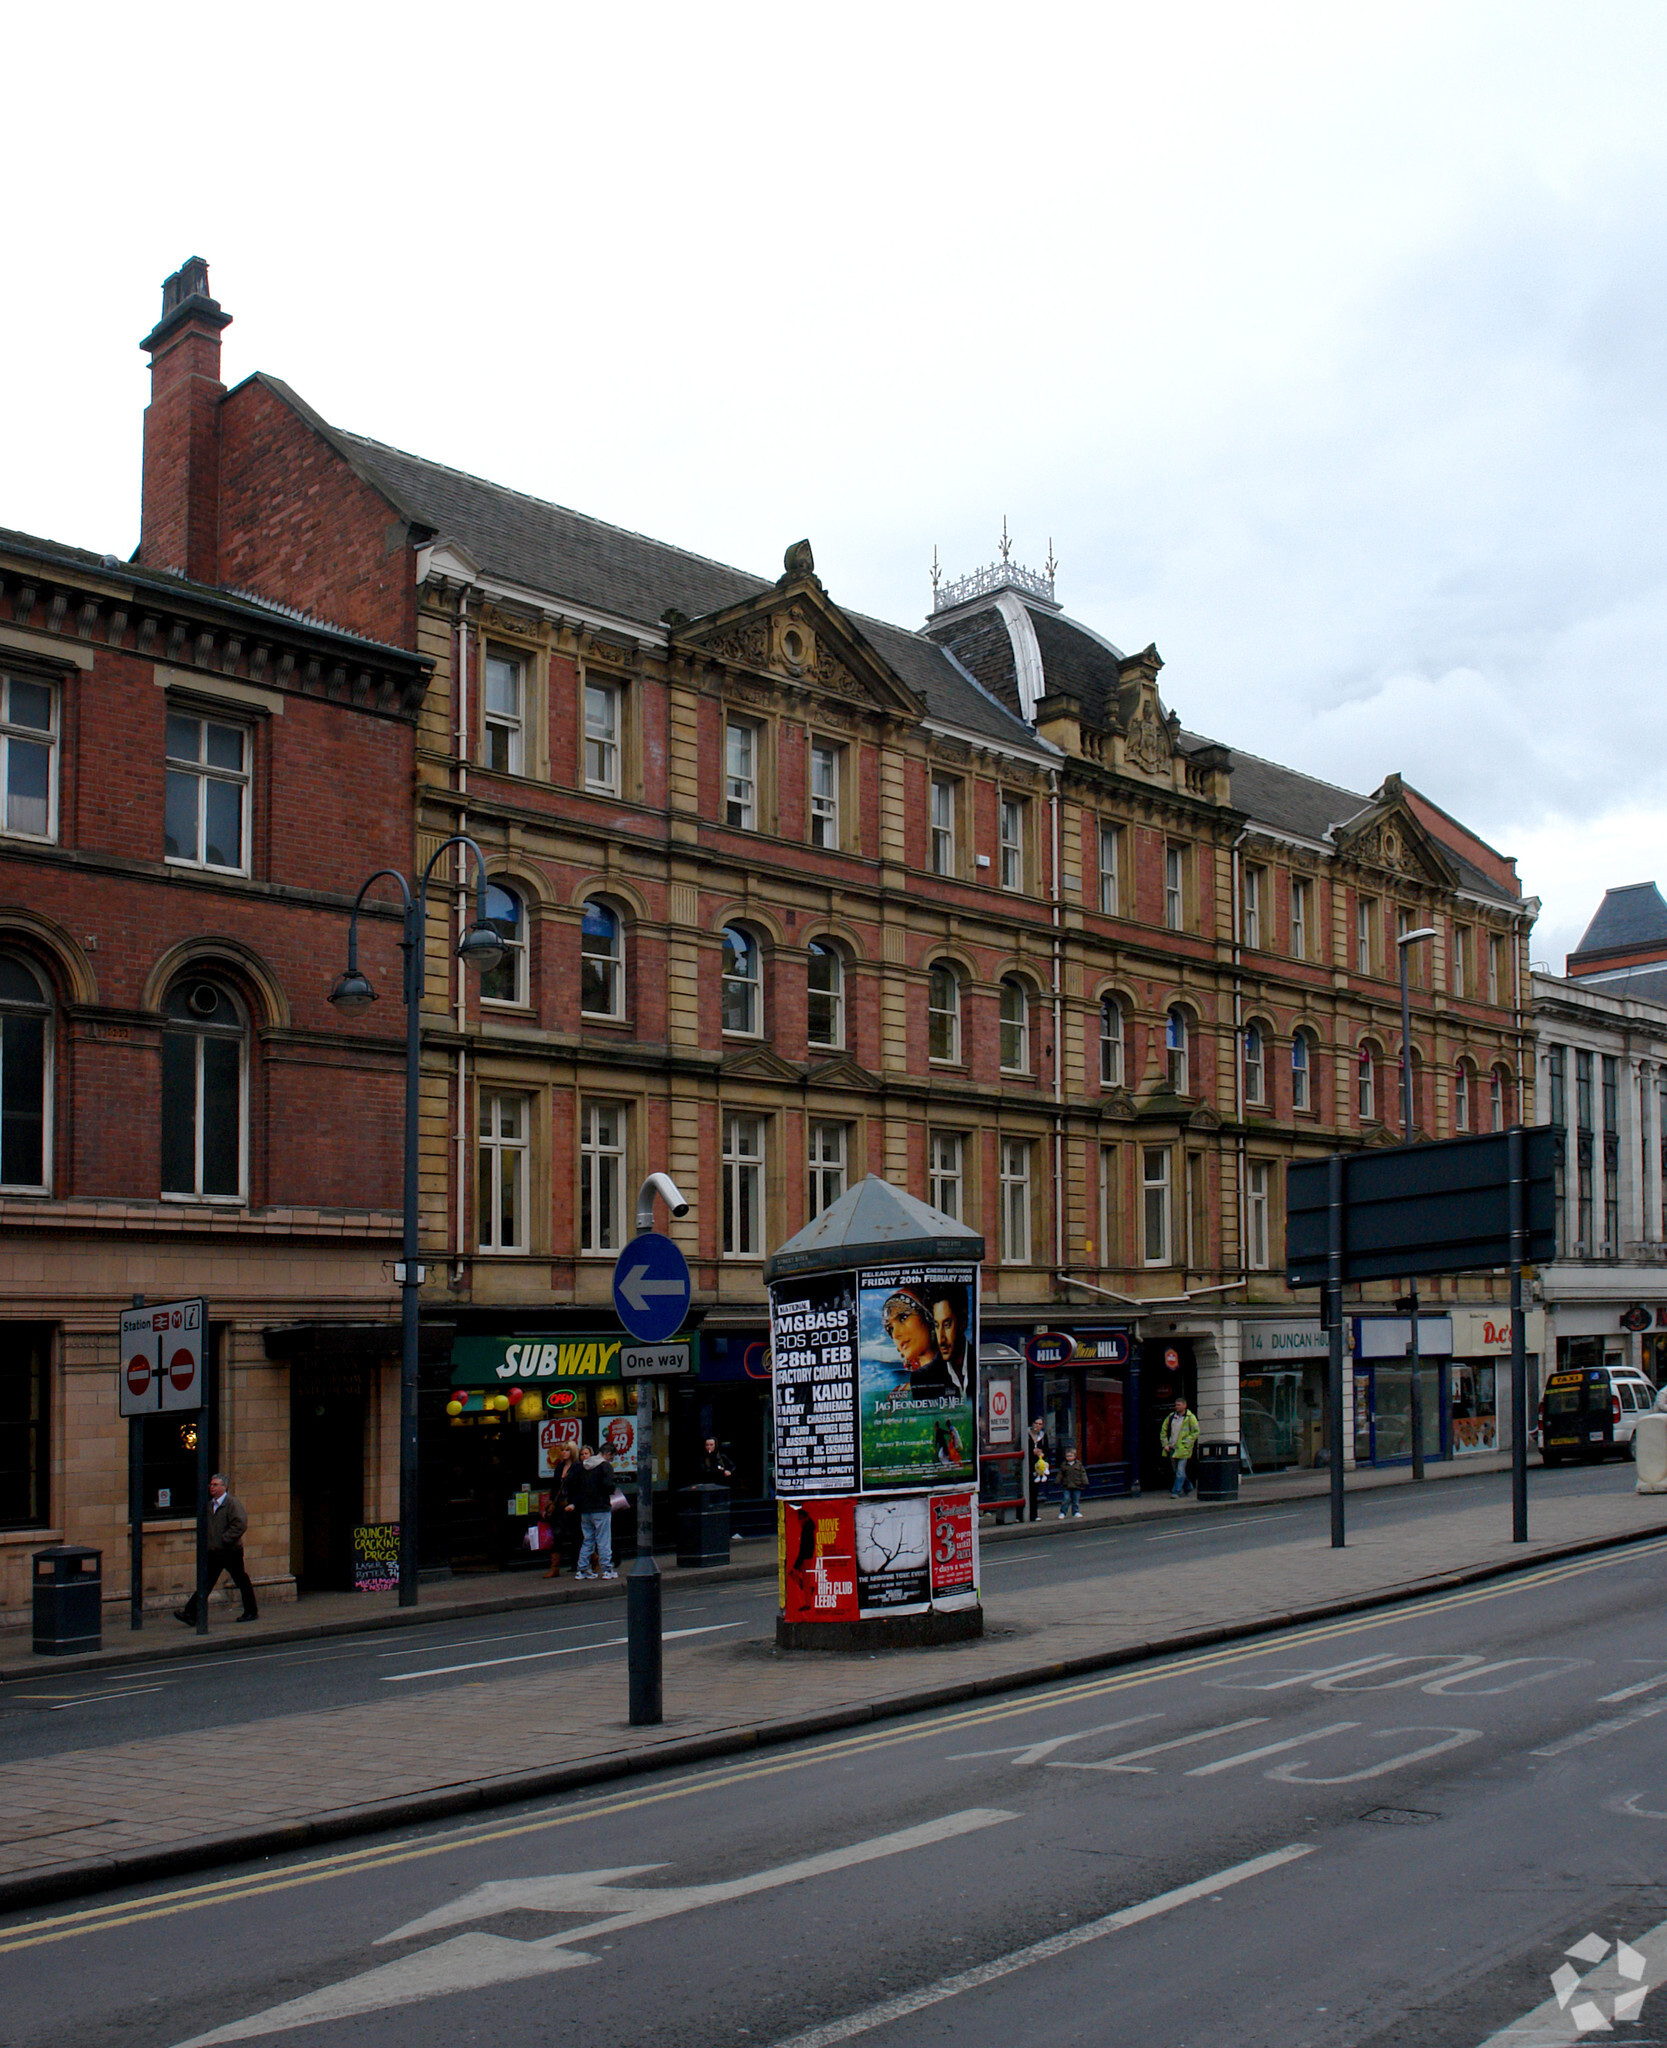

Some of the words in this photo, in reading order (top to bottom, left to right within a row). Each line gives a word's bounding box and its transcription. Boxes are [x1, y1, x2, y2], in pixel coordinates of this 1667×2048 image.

[861, 1269, 901, 1278] RELEASING
[901, 1268, 910, 1276] IN
[861, 1277, 897, 1287] FRIDAY
[899, 1275, 921, 1285] 20th
[924, 1274, 957, 1283] FEBRUARY
[957, 1274, 973, 1283] 2009
[123, 1320, 151, 1332] Station
[776, 1336, 806, 1350] RDS
[811, 1328, 850, 1347] 2009
[1250, 1334, 1263, 1350] 14
[1271, 1333, 1312, 1349] DUNCAN
[1314, 1332, 1330, 1347] HOU
[1036, 1348, 1063, 1362] HILL
[1097, 1341, 1119, 1358] HILL
[496, 1340, 623, 1379] SUBWAY
[627, 1354, 653, 1368] One
[658, 1354, 684, 1368] way
[777, 1349, 817, 1369] 28th
[821, 1346, 853, 1364] FEB
[776, 1367, 812, 1385] FACTORY
[812, 1364, 854, 1382] COMPLEX
[1557, 1375, 1579, 1383] TAXI
[812, 1382, 854, 1402] KANO
[549, 1393, 574, 1406] OPEN
[874, 1400, 891, 1415] JAG
[543, 1421, 577, 1443] £1.79
[353, 1525, 393, 1539] CRUNCH
[818, 1518, 840, 1532] MOVE
[955, 1530, 972, 1541] open
[354, 1536, 400, 1552] CRACKING
[935, 1522, 956, 1564] 3
[956, 1538, 972, 1549] until
[364, 1549, 398, 1562] PRICES
[956, 1548, 972, 1560] am
[939, 1564, 954, 1573] days
[354, 1578, 378, 1588] MUCH
[810, 1569, 829, 1583] THE
[833, 1580, 853, 1595] CLUB
[814, 1594, 838, 1608] LEEDS
[945, 1712, 1484, 1783] CITY
